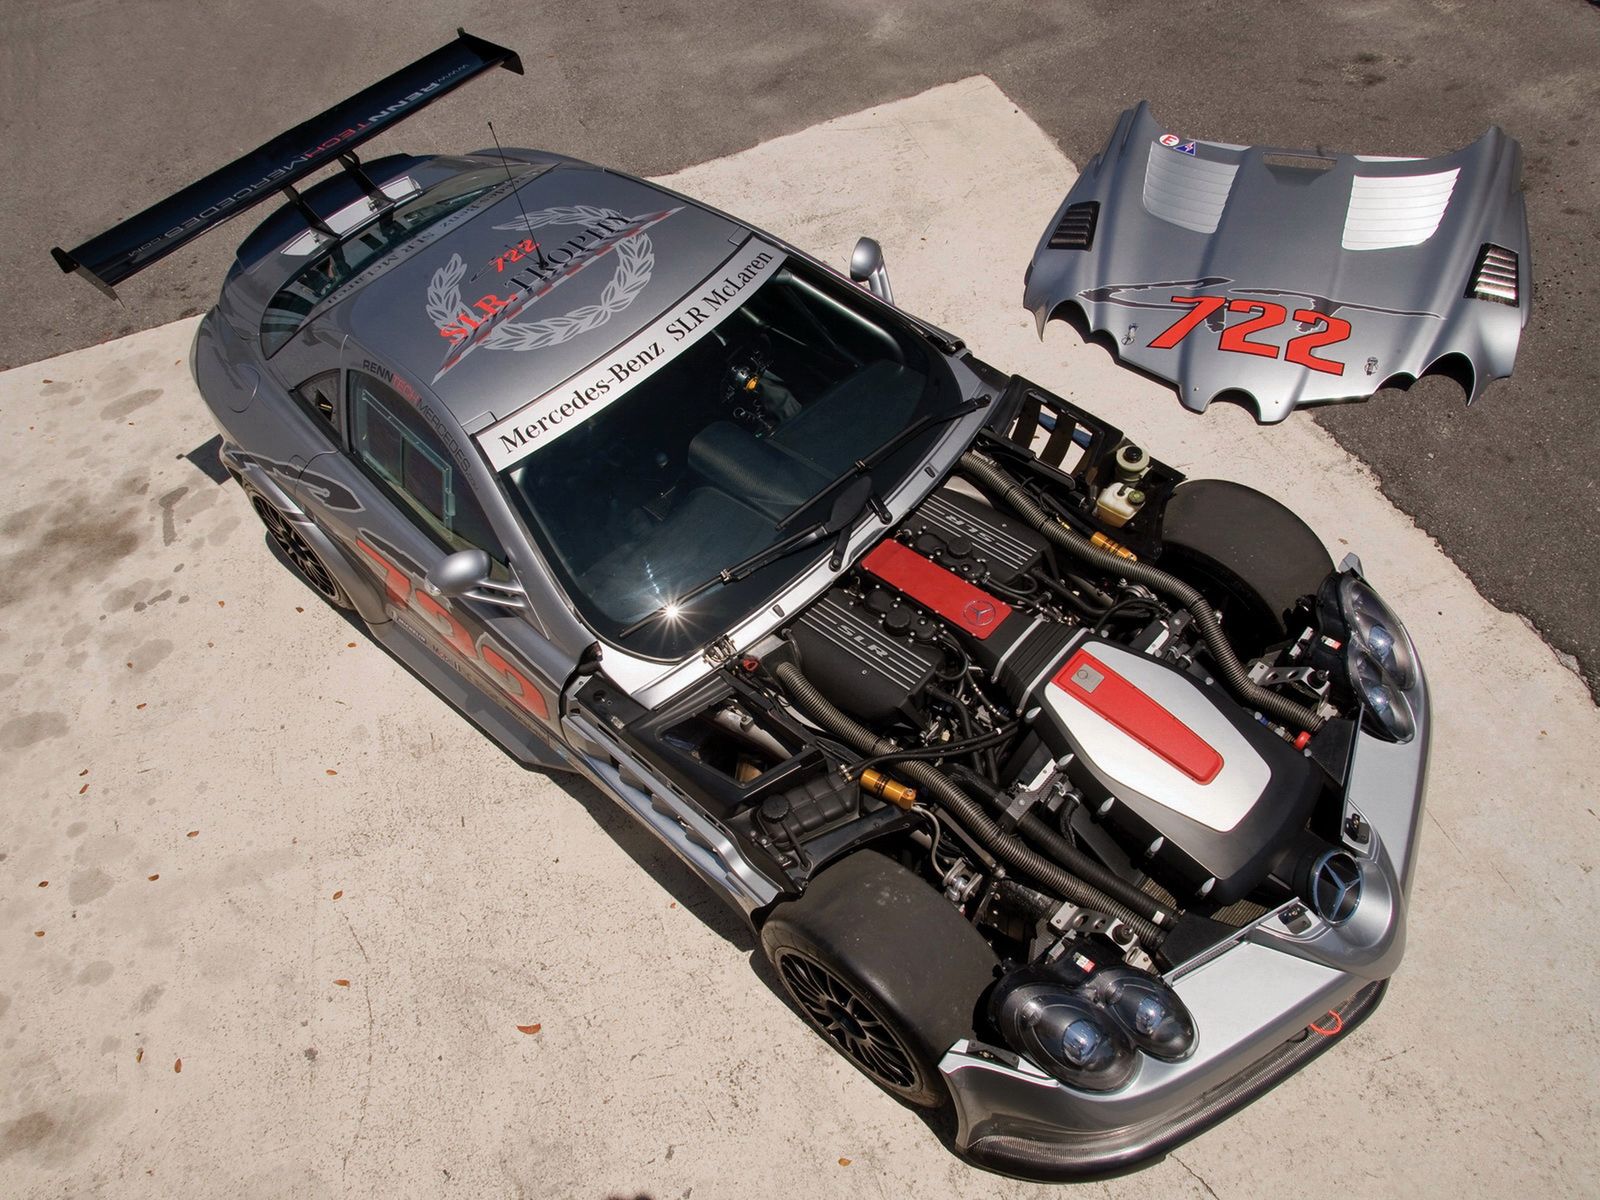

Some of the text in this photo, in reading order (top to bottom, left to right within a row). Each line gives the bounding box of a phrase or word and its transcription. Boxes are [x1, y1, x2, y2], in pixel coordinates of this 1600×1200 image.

[1161, 135, 1179, 147] E
[489, 239, 541, 273] 722
[498, 251, 774, 454] Mercedes-Benz SLR McLaren
[1146, 296, 1352, 376] 722
[943, 513, 996, 543] SLR
[837, 624, 889, 658] SLR
